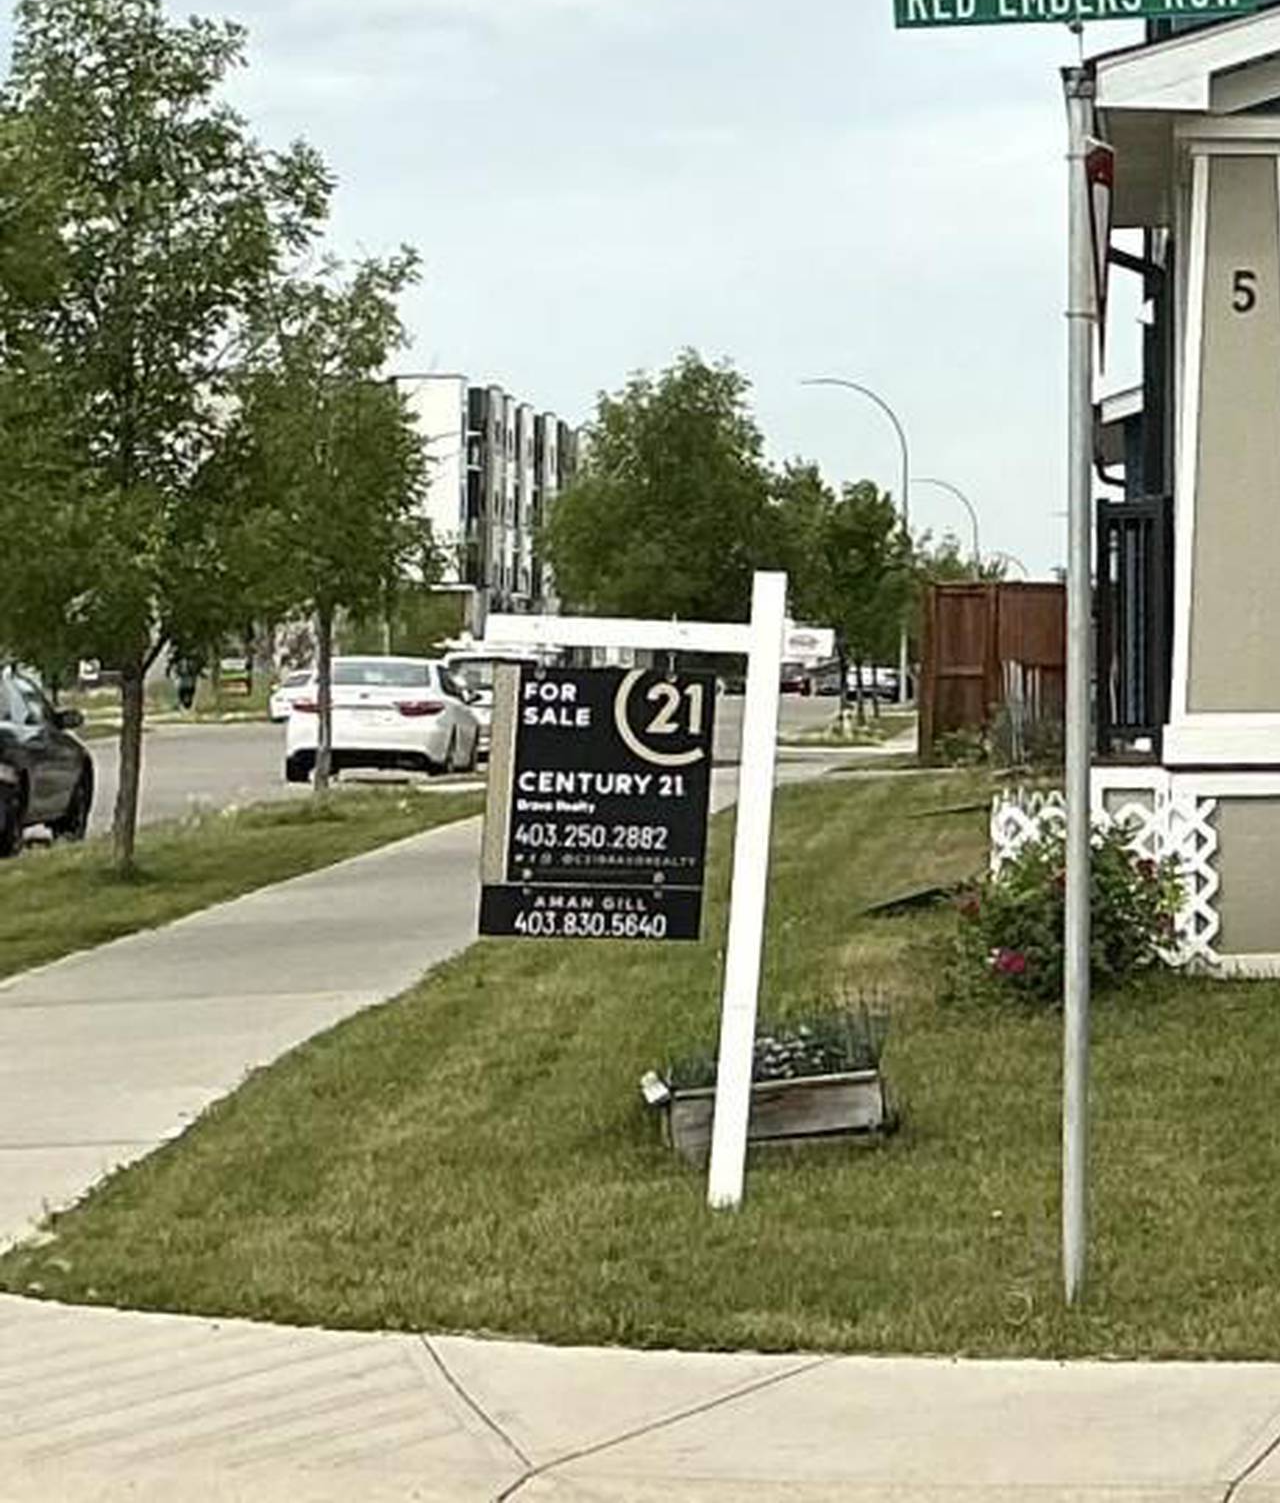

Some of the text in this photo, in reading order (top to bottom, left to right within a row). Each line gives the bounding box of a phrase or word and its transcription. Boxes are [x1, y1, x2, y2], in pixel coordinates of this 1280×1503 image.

[1232, 271, 1257, 312] 5
[524, 682, 577, 701] FOR
[523, 706, 591, 727] SALE
[518, 771, 684, 796] CENTURY 21
[515, 823, 668, 849] 403.250.2882
[533, 896, 647, 911] AMAN GILL
[514, 911, 667, 937] 403.830.5640
